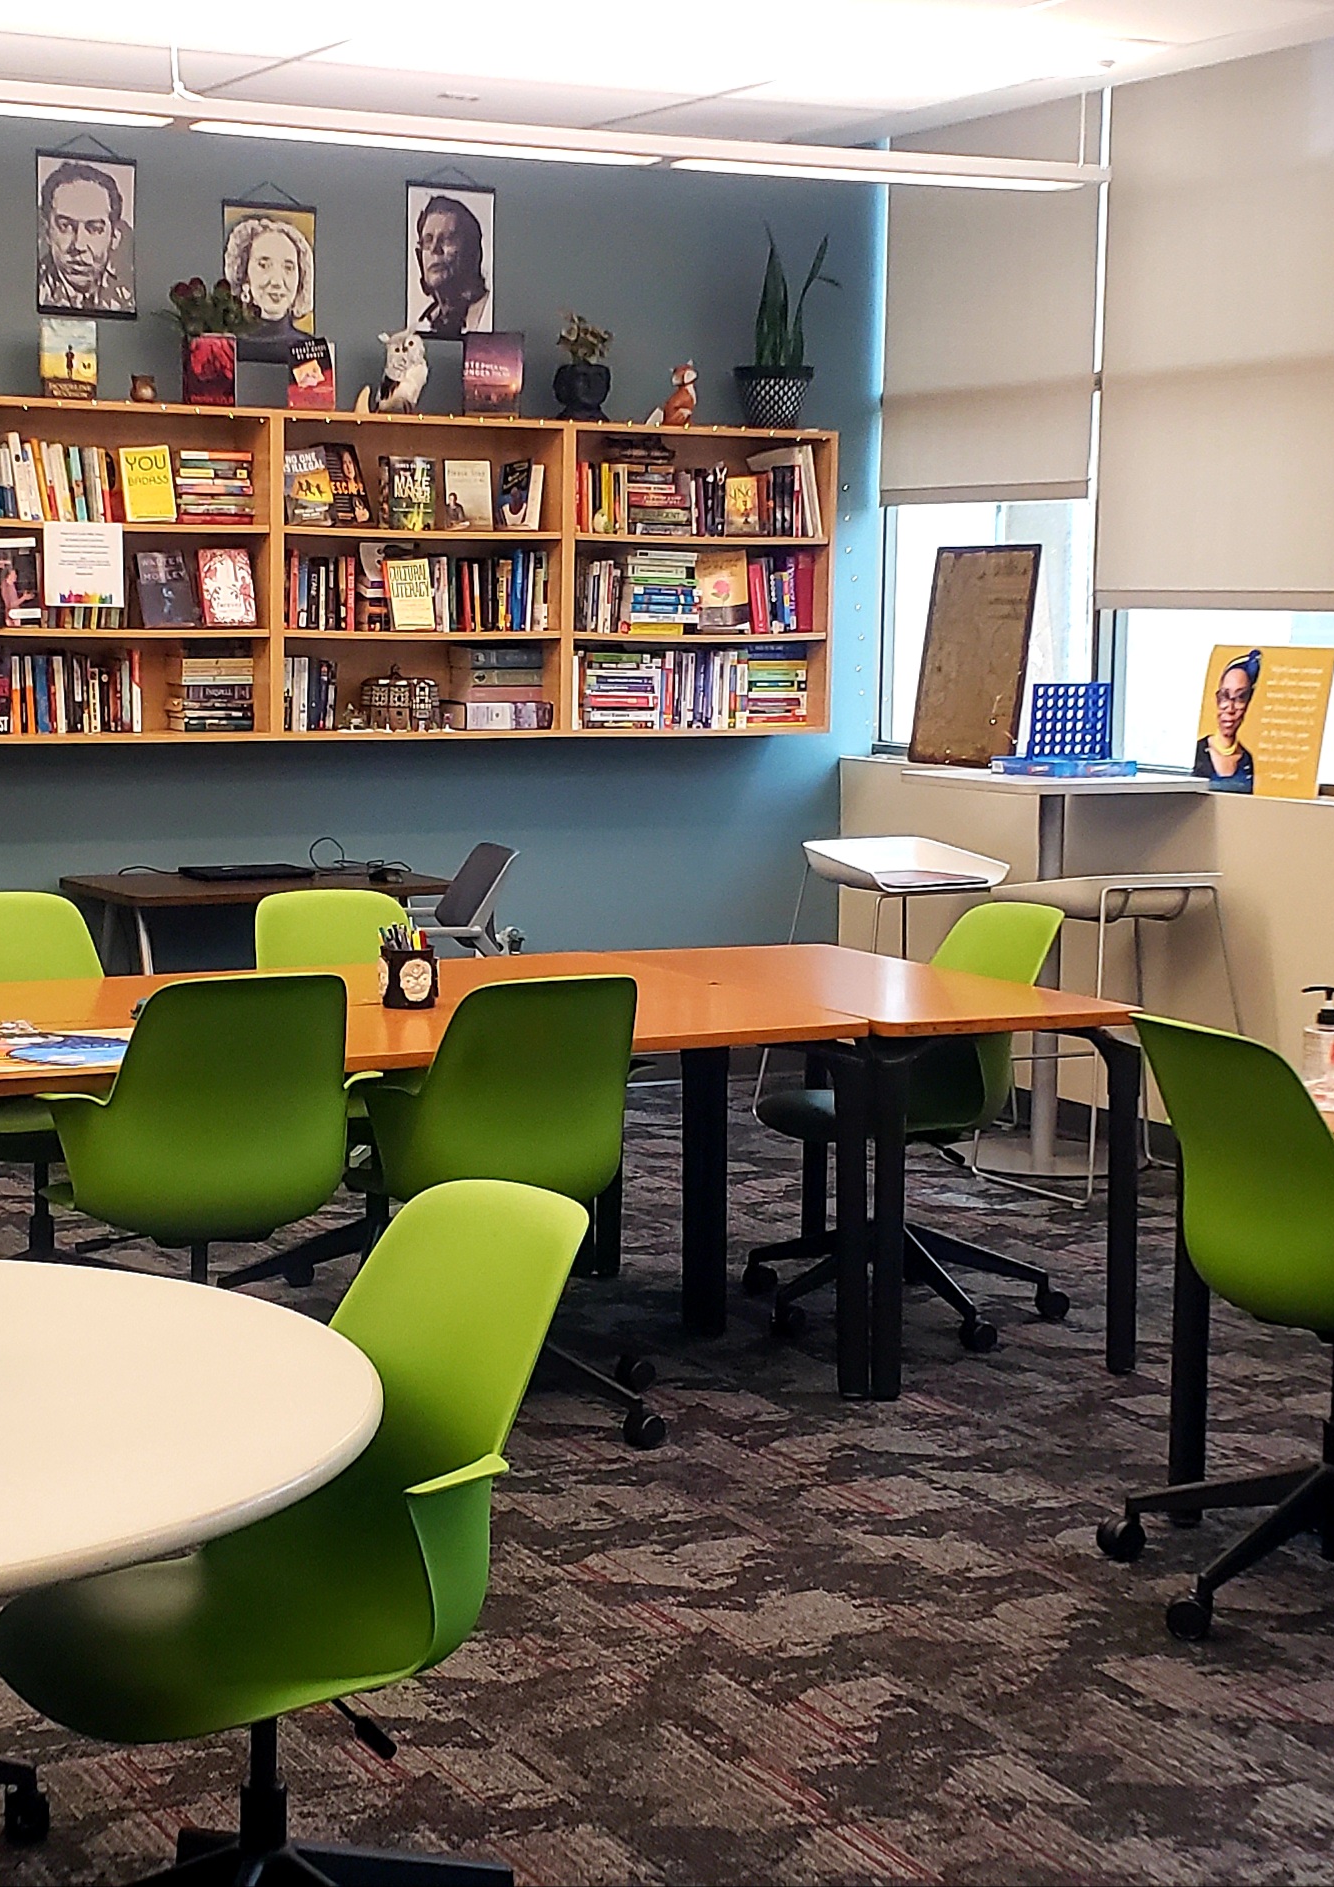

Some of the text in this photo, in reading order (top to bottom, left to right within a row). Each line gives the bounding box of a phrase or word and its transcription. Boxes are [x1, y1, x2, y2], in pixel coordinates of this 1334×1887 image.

[125, 453, 166, 471] YOU
[330, 481, 365, 495] ESCAPE
[394, 475, 430, 489] MAZE
[389, 564, 427, 582] CULTURAL
[391, 580, 429, 598] LITERACY
